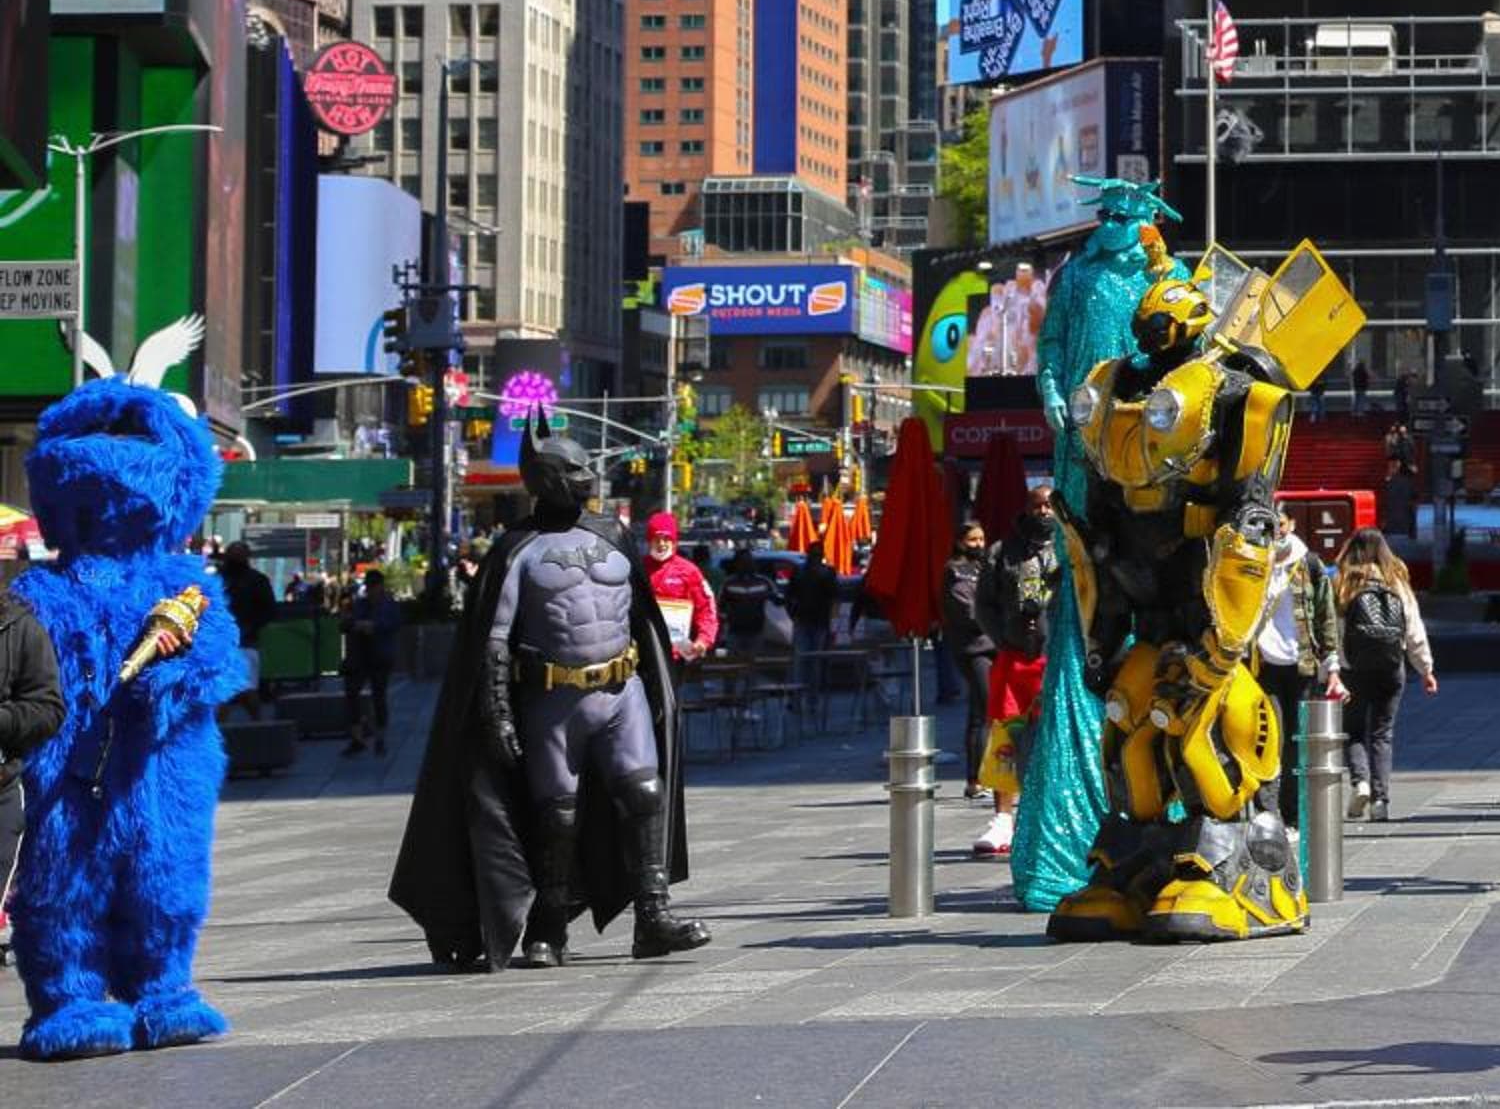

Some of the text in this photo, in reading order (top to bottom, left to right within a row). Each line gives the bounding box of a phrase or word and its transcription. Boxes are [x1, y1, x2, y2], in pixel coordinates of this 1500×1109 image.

[37, 269, 72, 286] ZONE
[21, 292, 72, 310] MOVING
[709, 283, 806, 306] SHOUT
